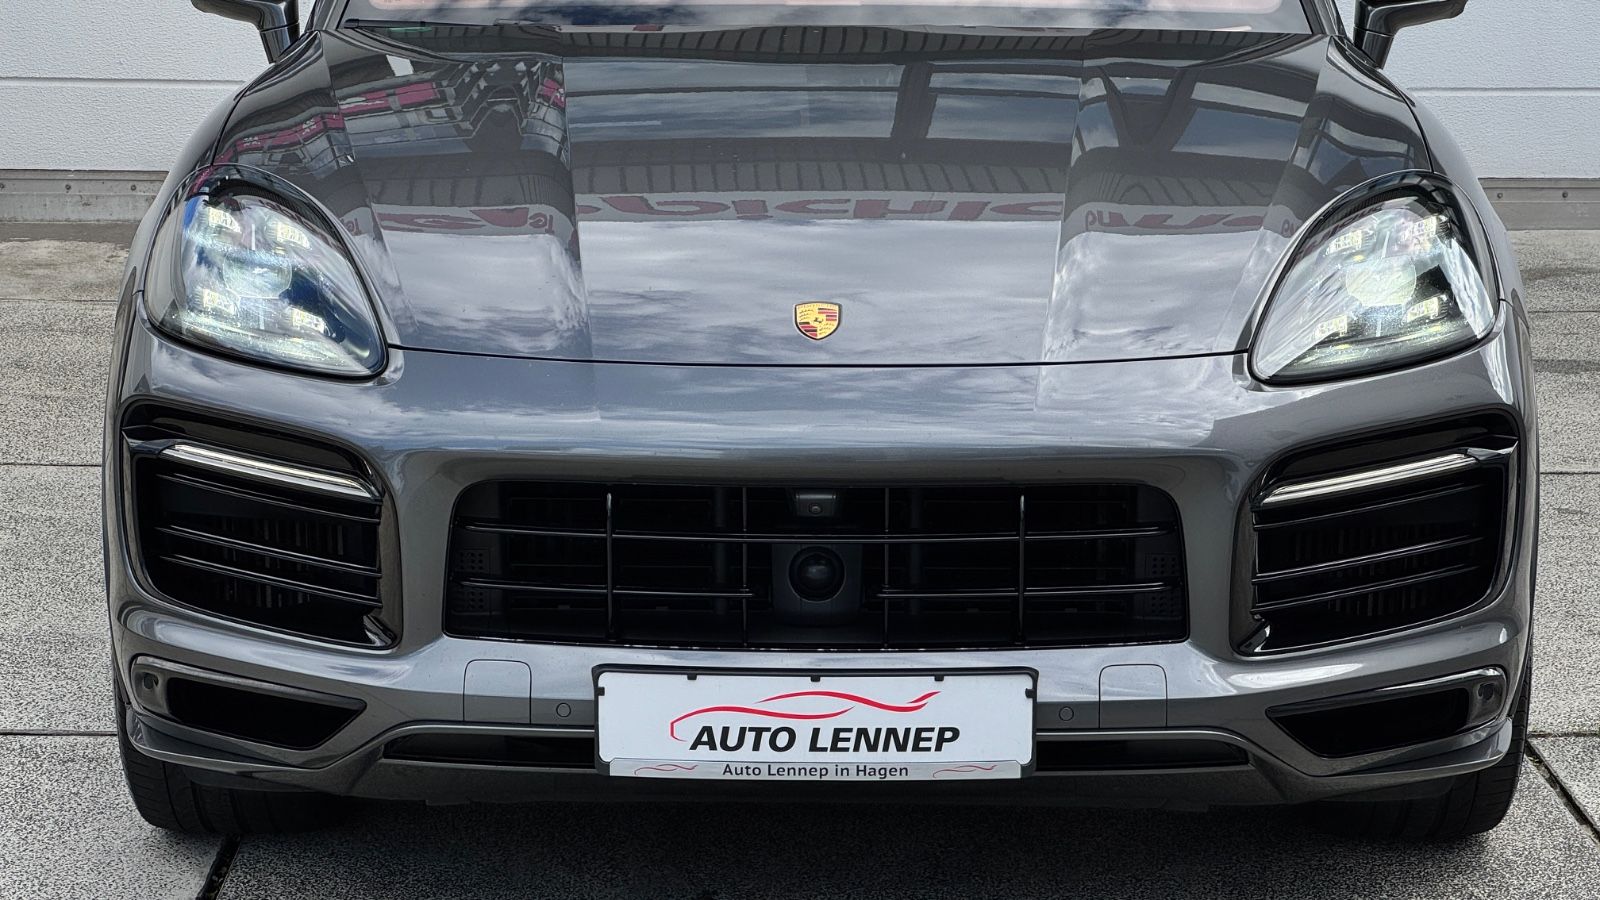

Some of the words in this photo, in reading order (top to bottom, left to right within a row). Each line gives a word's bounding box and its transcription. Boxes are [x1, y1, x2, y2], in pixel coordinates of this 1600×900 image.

[689, 725, 797, 752] AUTO
[808, 726, 960, 752] LENNEP
[722, 763, 762, 776] Auto
[767, 764, 829, 779] Lennep
[835, 764, 850, 777] in
[856, 764, 909, 780] Hagen
